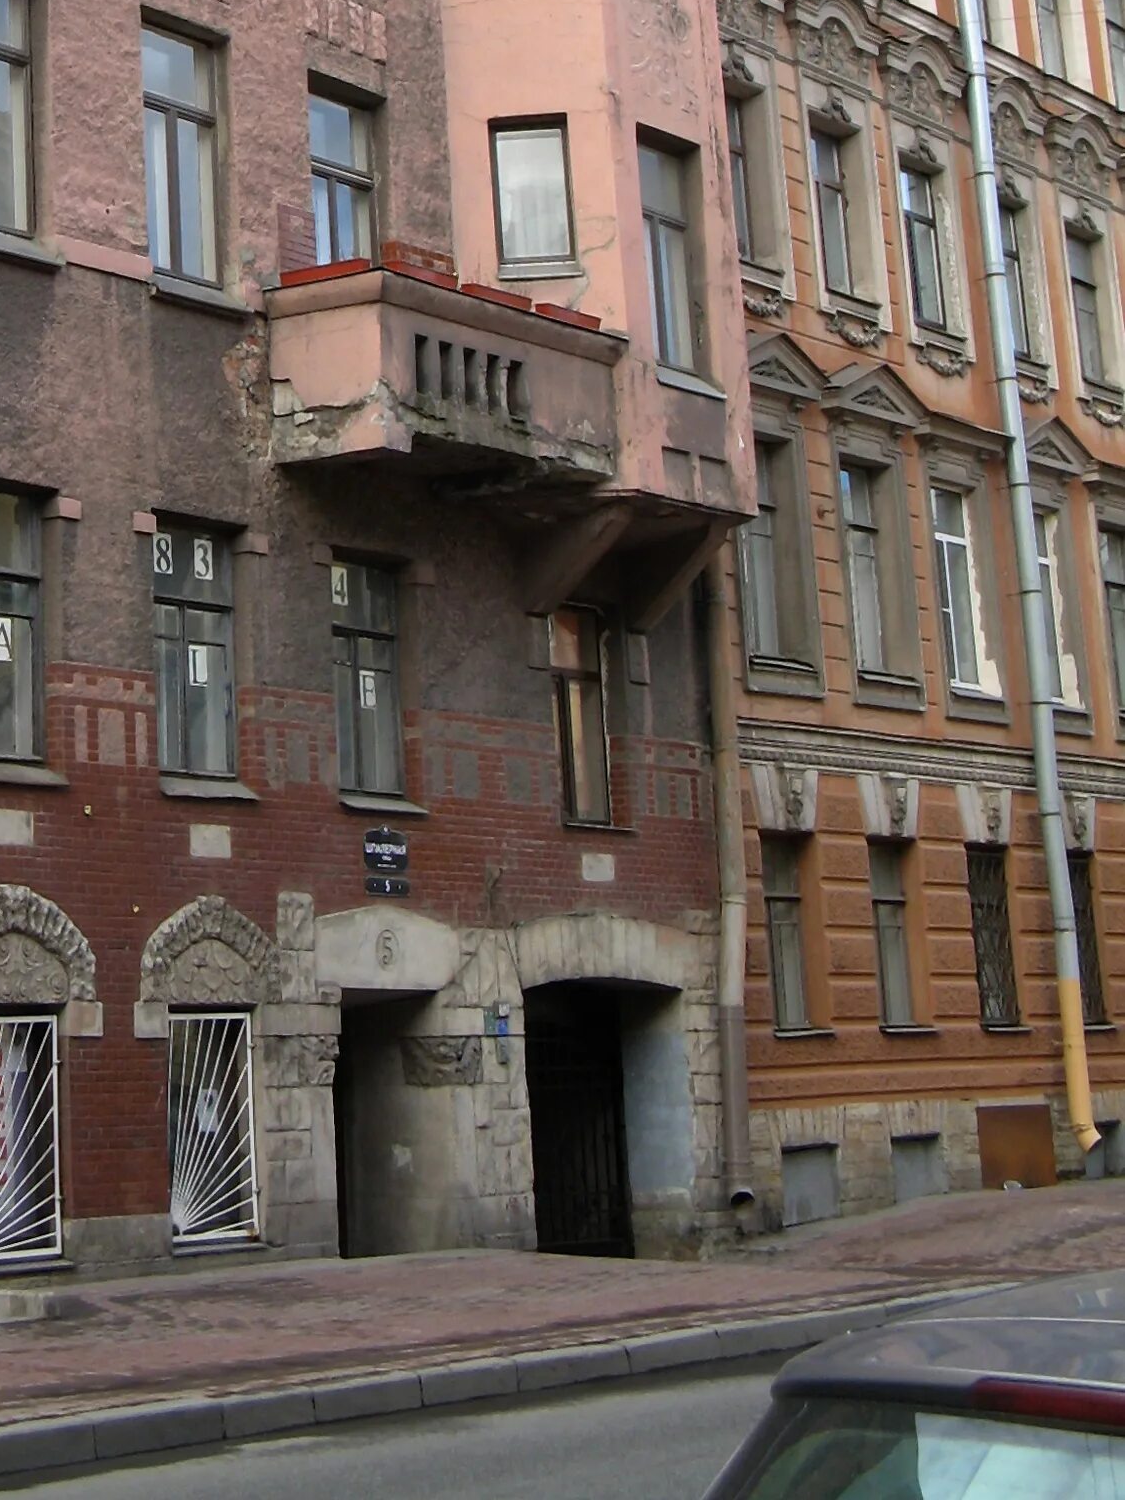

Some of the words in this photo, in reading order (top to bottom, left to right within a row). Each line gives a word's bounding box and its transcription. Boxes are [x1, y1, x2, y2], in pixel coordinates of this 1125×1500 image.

[156, 537, 171, 572] 8
[196, 543, 210, 577] 3
[334, 572, 347, 603] 4
[190, 649, 207, 685] L
[382, 936, 394, 966] 5
